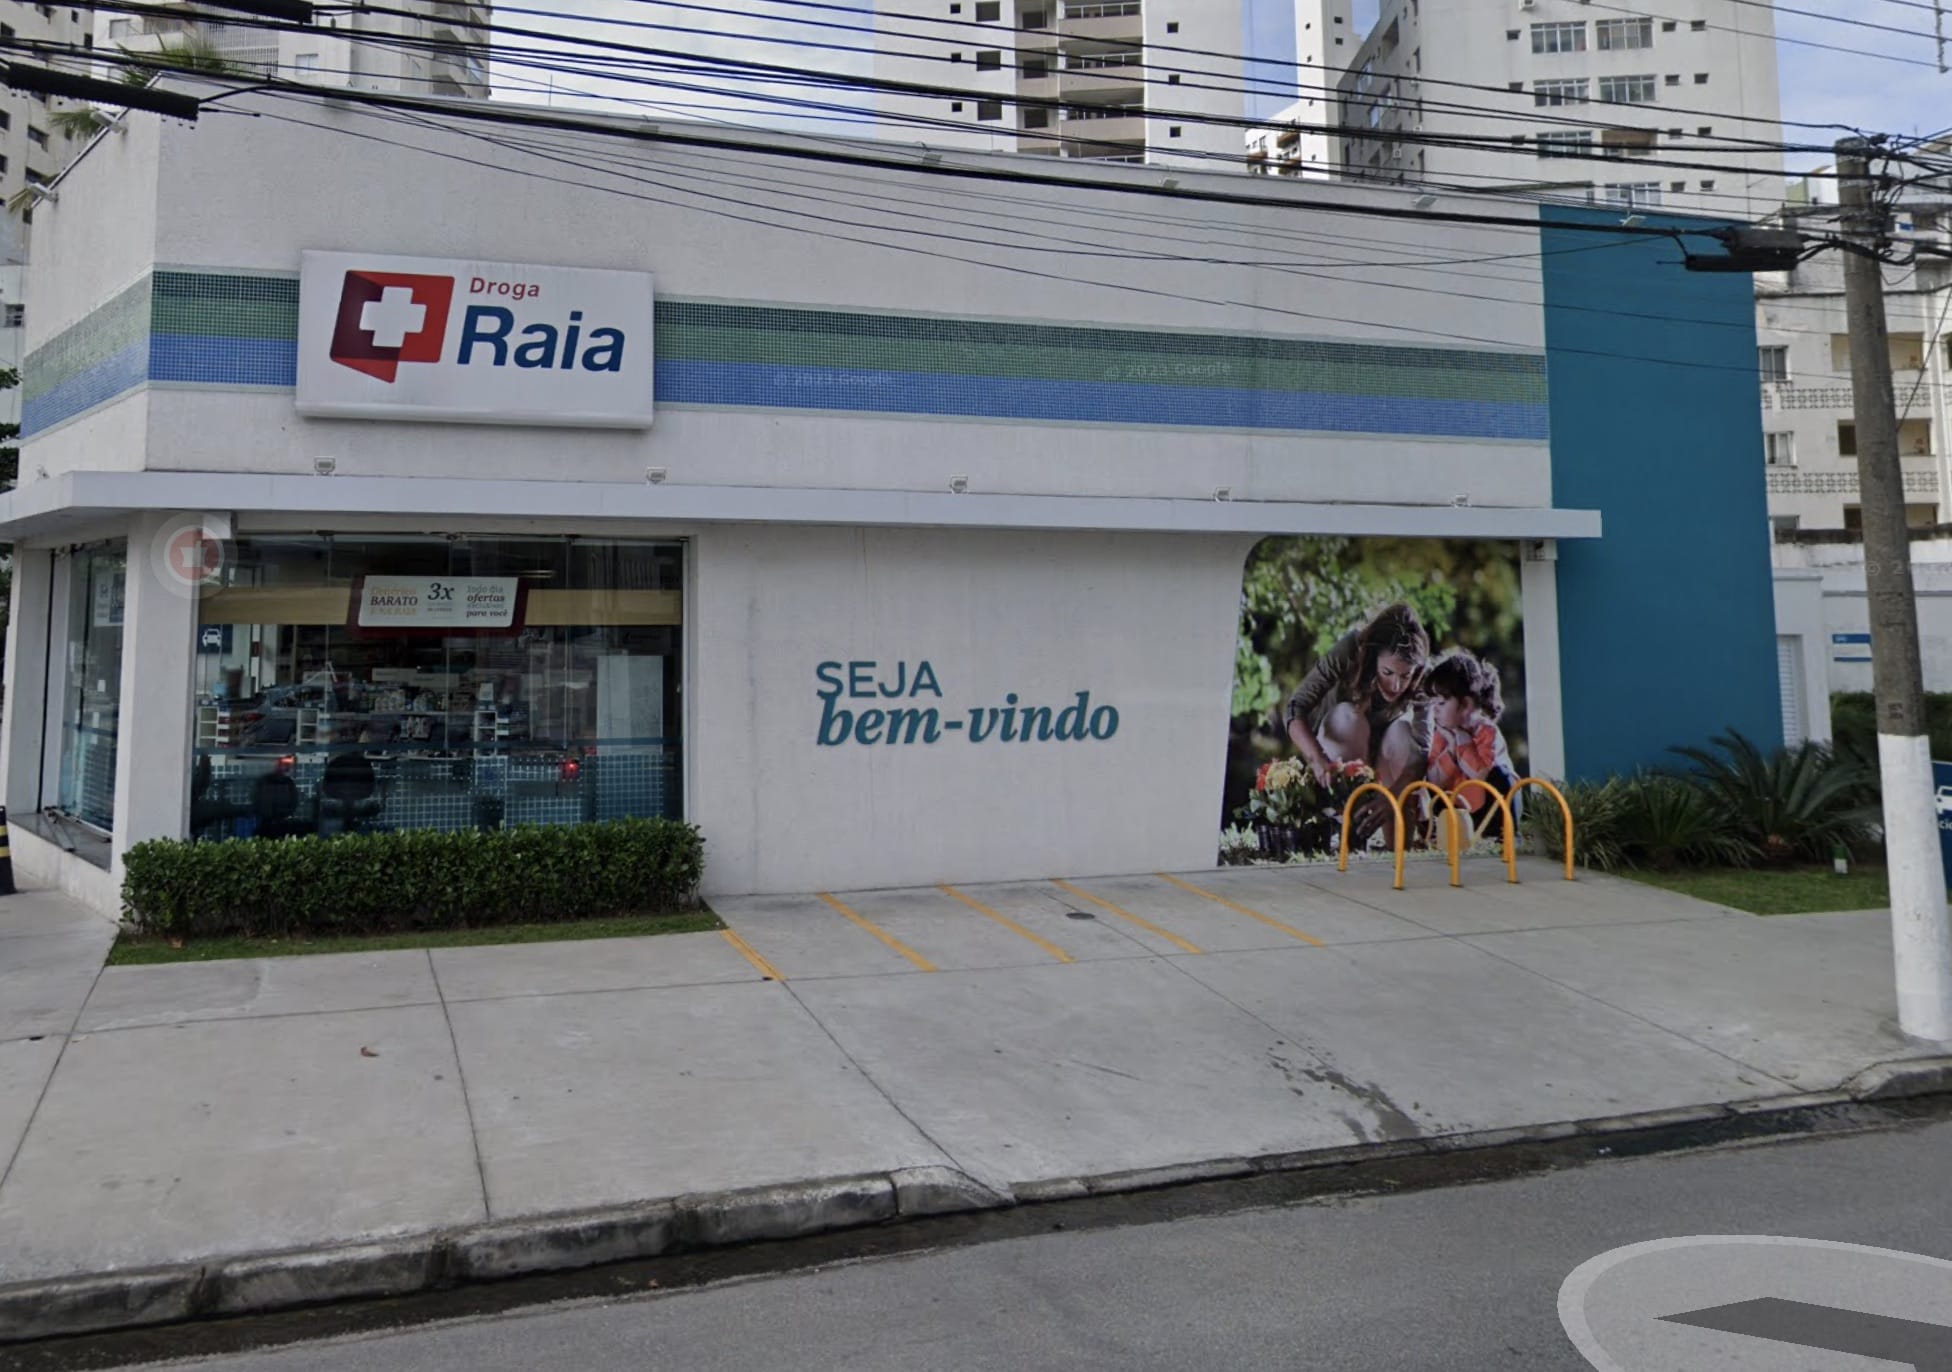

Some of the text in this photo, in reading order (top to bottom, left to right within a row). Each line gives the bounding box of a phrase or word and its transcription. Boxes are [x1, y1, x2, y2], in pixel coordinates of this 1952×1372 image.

[469, 277, 540, 301] Droga
[457, 305, 626, 373] Raia
[370, 595, 418, 607] BARATO
[427, 582, 455, 600] 3x
[467, 593, 506, 603] ofertas
[466, 610, 487, 619] para
[816, 661, 943, 698] SEJA
[816, 690, 1120, 746] bem-vindo
